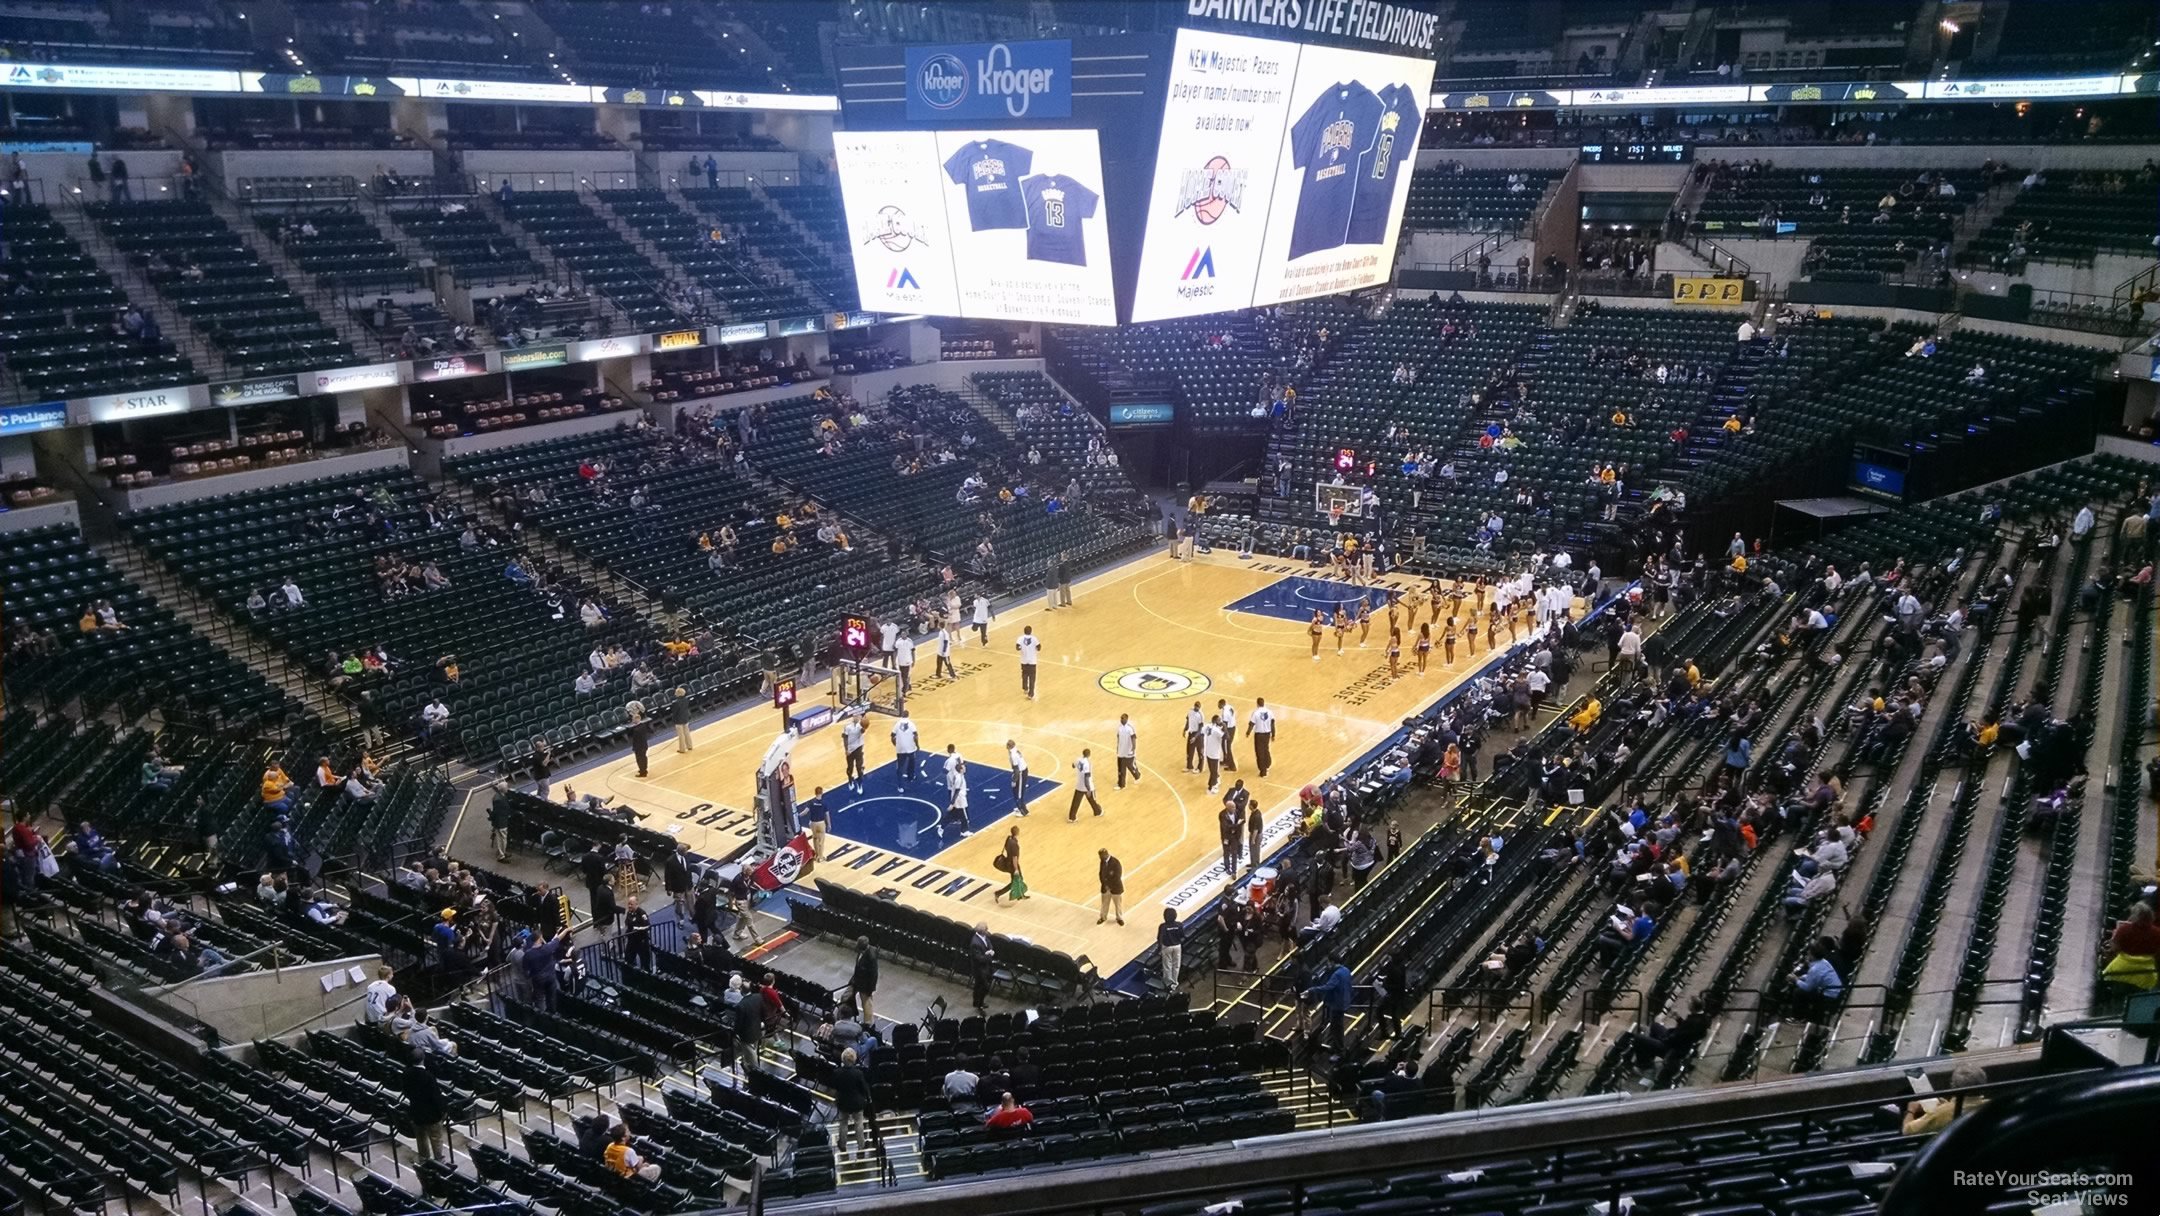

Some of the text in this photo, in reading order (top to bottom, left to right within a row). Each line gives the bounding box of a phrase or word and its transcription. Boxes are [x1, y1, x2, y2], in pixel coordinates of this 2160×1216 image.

[1303, 0, 1345, 34] LIFE
[1345, 0, 1439, 50] FIELDHOUSE
[1189, 49, 1279, 75] NEW Majestic Pacers
[924, 63, 964, 101] Kroger
[977, 44, 1054, 117] Kroger
[1173, 80, 1202, 103] player
[1195, 113, 1233, 131] available
[1045, 200, 1065, 227] 13
[1177, 285, 1215, 301] Majestic
[722, 324, 765, 338] ticketmaster
[503, 350, 566, 364] bankerslife.com
[127, 395, 168, 410] STAR
[847, 628, 865, 646] 24
[1333, 662, 1400, 700] IELDHOUSE
[1346, 690, 1377, 706] LIFE
[826, 843, 992, 902] INDIANA
